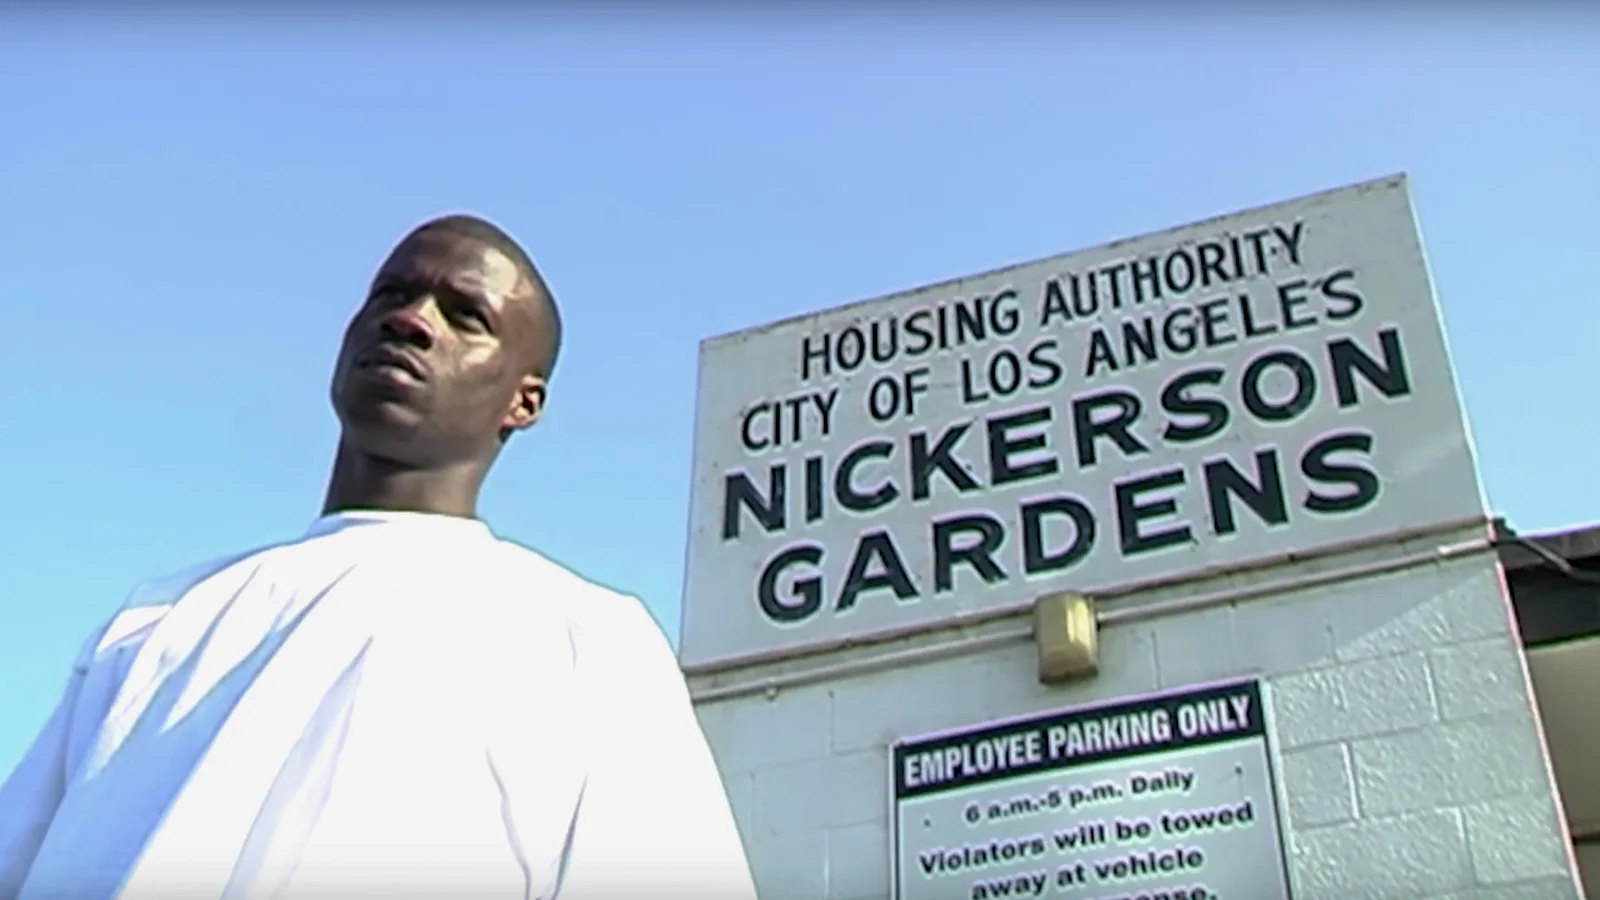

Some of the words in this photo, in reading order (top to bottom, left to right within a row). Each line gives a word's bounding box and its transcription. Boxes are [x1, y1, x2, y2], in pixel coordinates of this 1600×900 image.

[741, 390, 840, 450] CITY
[870, 369, 929, 421] OF
[962, 340, 1061, 403] LOS
[1085, 269, 1364, 376] ANGELES
[802, 292, 1019, 380] HOUSING
[1040, 223, 1305, 327] AUTHORITY
[722, 329, 1410, 541] NICKERSON
[757, 432, 1380, 622] GARDENS
[905, 735, 1041, 787] EMPLOYEE
[1048, 709, 1169, 758] PARKING
[1178, 696, 1251, 736] ONLY
[966, 806, 979, 823] 6
[1070, 784, 1124, 811] p.m.
[1131, 770, 1194, 795] Daily
[921, 837, 1045, 874] Violators
[1055, 826, 1106, 850] will
[1116, 815, 1151, 842] be
[1162, 802, 1253, 834] towed
[972, 870, 1046, 900] away
[1058, 863, 1085, 885] at
[1095, 848, 1204, 880] vehicle
